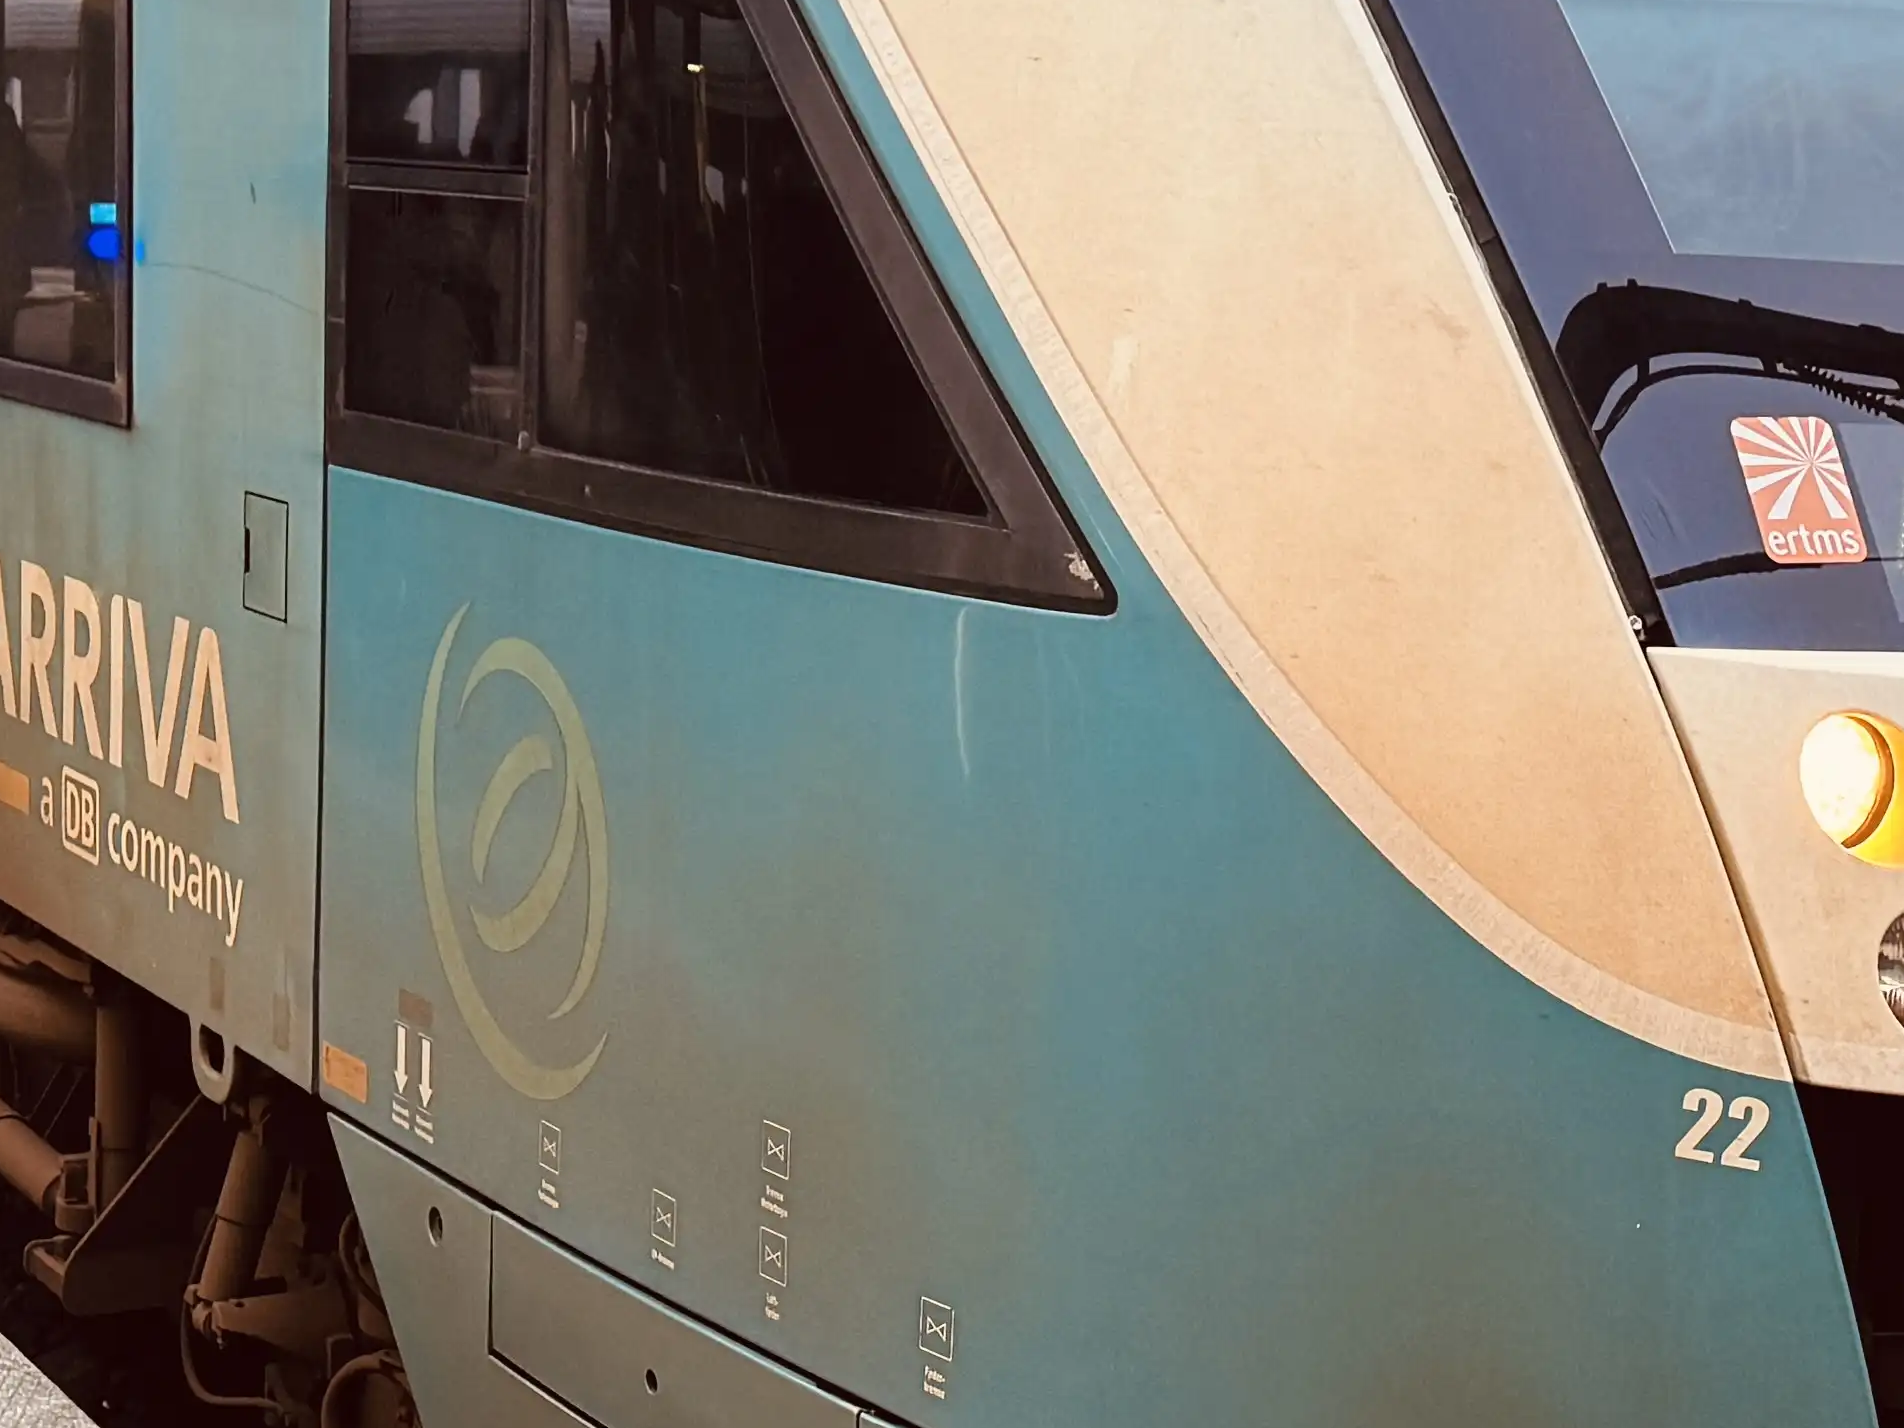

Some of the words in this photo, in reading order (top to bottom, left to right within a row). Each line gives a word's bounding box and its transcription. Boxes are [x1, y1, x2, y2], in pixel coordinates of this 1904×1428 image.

[1767, 523, 1861, 557] ertms
[40, 775, 55, 827] a
[64, 776, 97, 851] DB
[107, 811, 244, 948] company
[1674, 1087, 1770, 1172] 22
